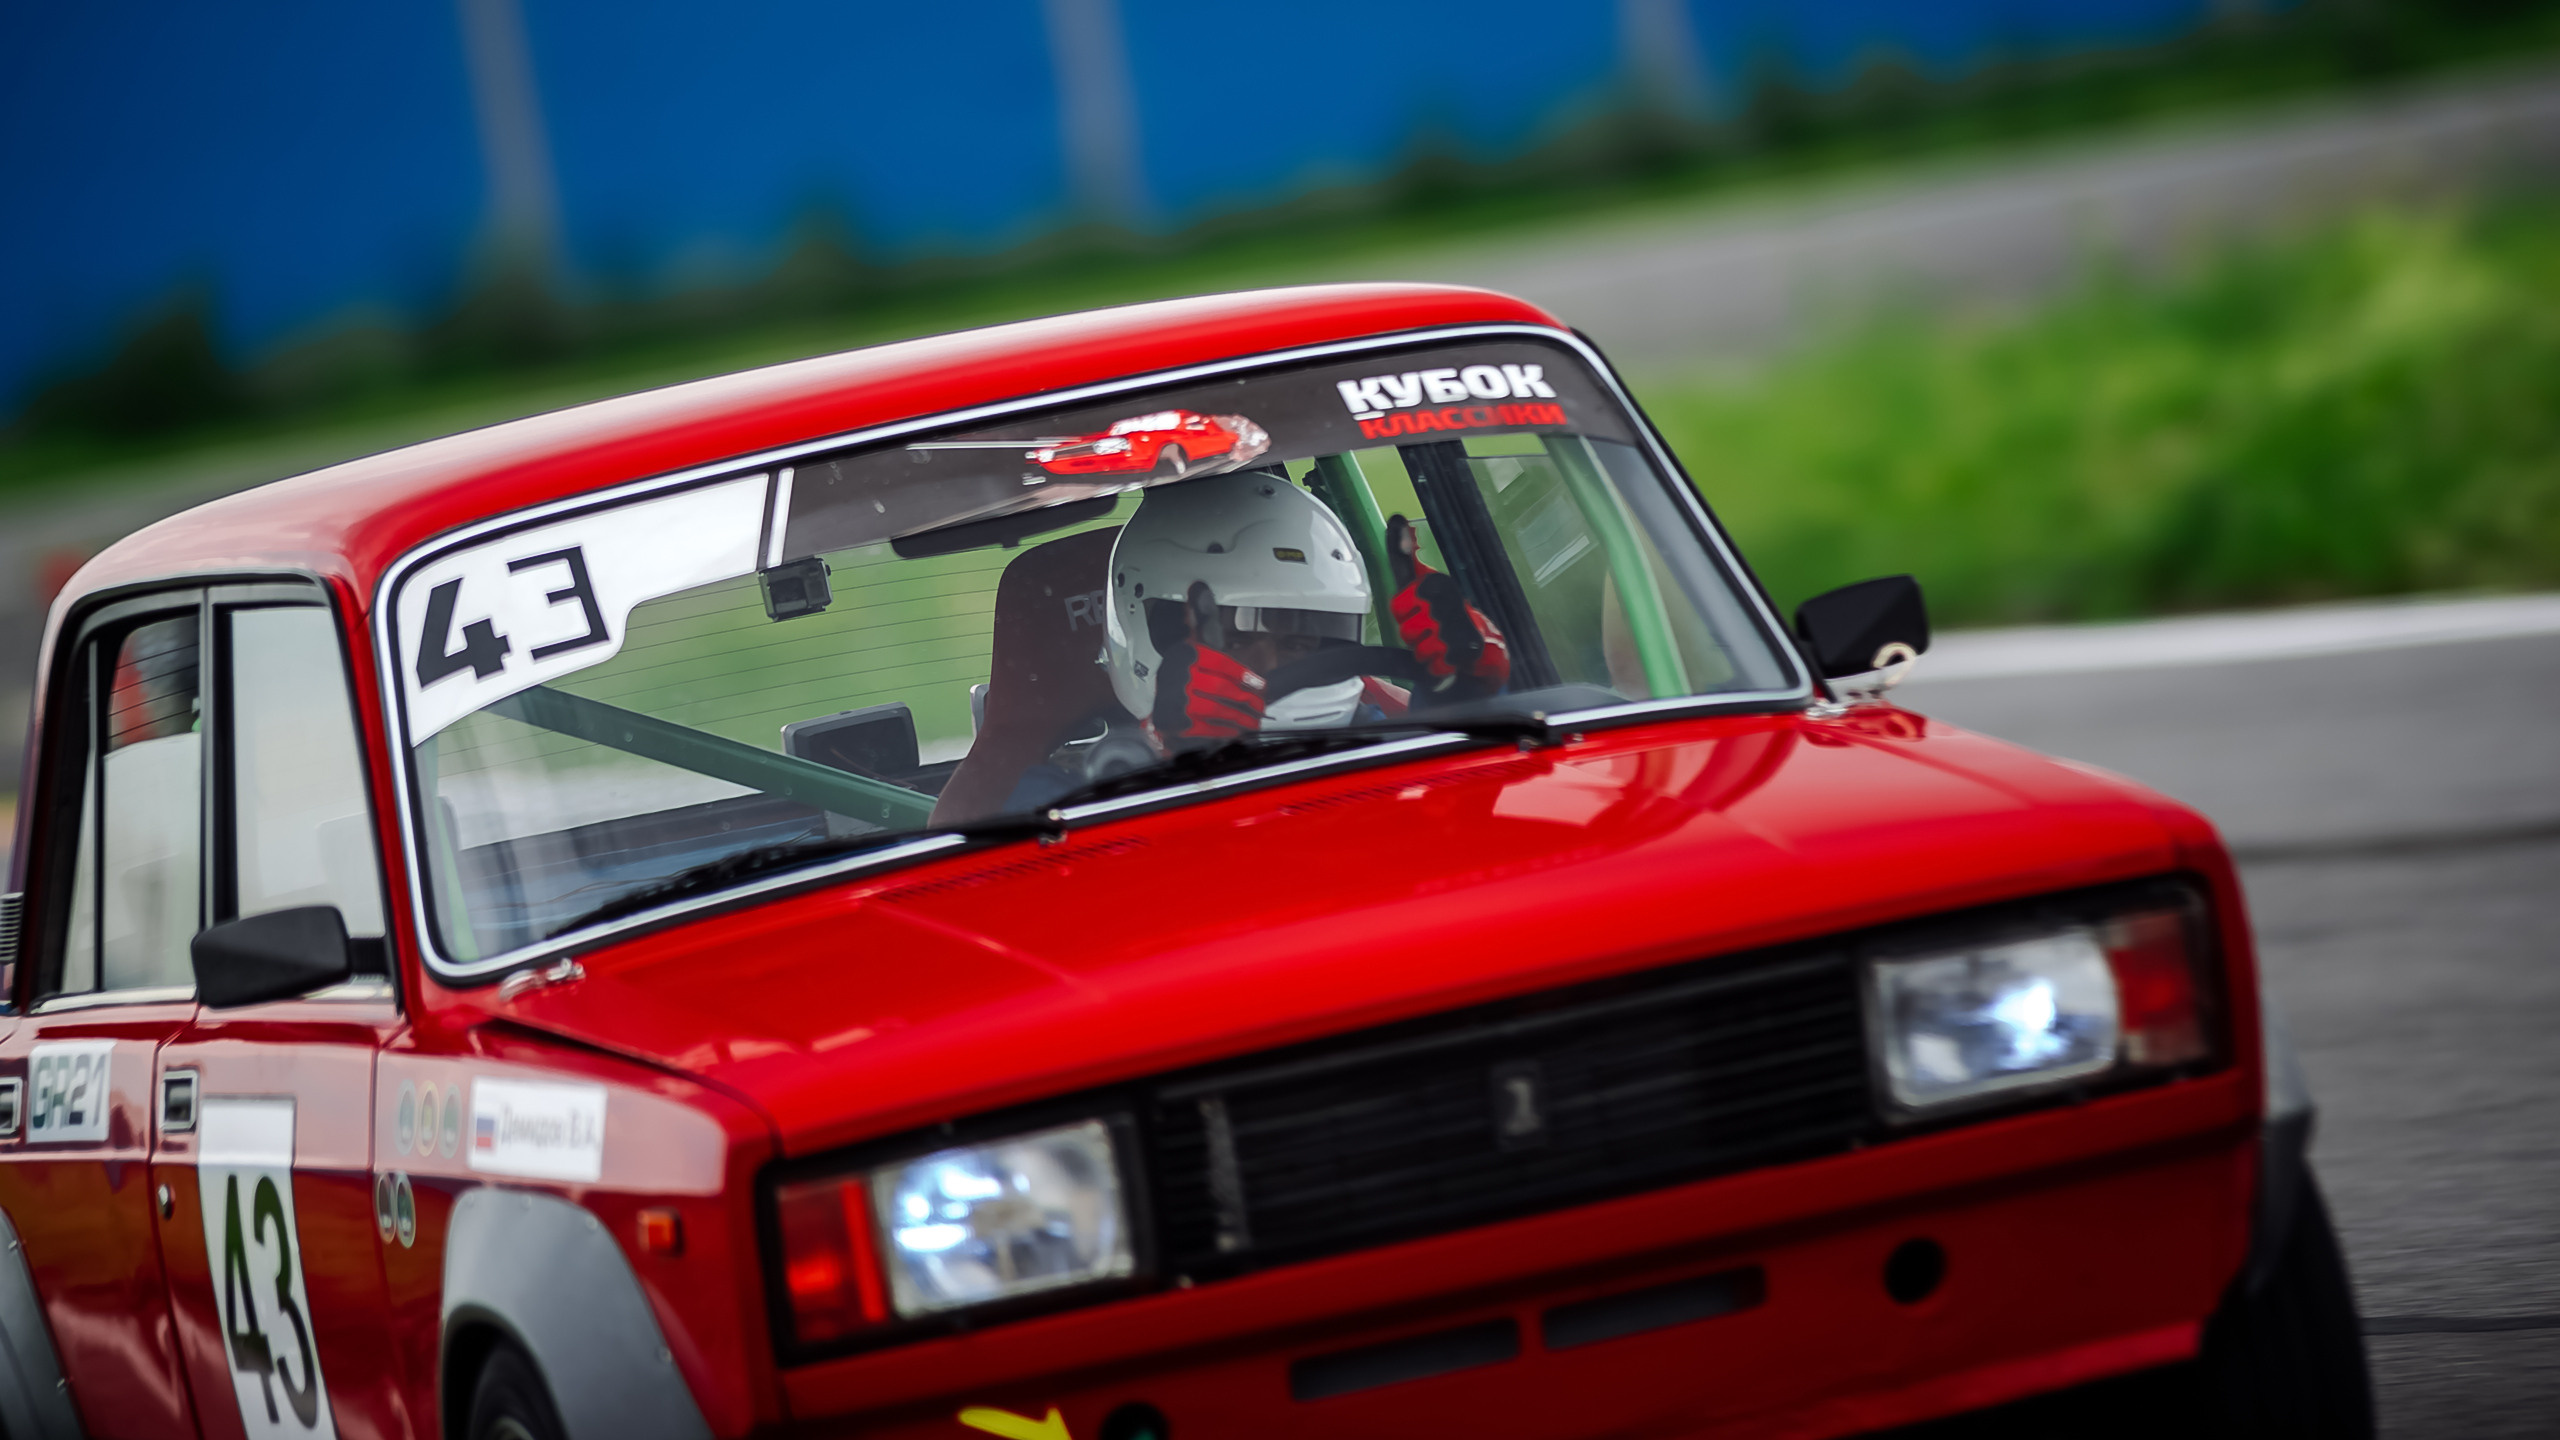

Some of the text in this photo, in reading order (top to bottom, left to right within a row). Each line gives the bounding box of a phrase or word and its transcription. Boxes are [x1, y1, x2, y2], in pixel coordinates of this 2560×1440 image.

[1336, 364, 1557, 411] КУБОК
[1357, 402, 1567, 440] КЛАССИКИ
[416, 546, 609, 688] 43
[225, 1174, 317, 1430] 43
